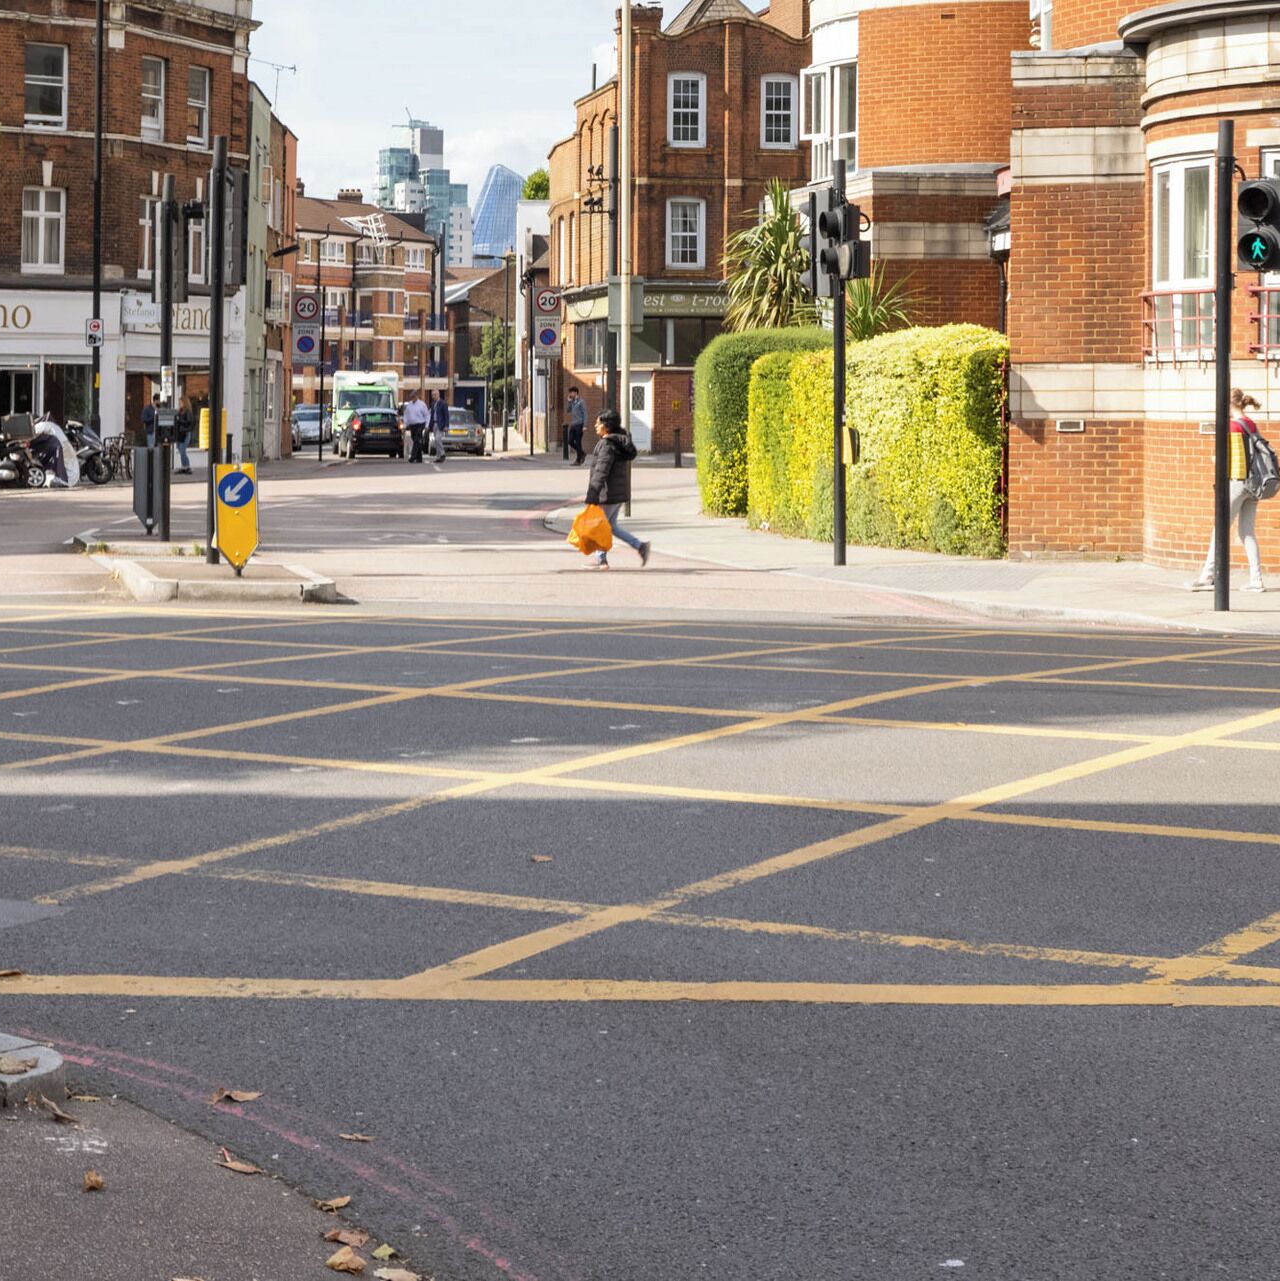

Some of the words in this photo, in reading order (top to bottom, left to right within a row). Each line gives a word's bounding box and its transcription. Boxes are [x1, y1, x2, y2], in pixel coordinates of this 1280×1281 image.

[540, 296, 556, 306] 20
[123, 306, 155, 317] Stefano
[299, 303, 315, 312] 20
